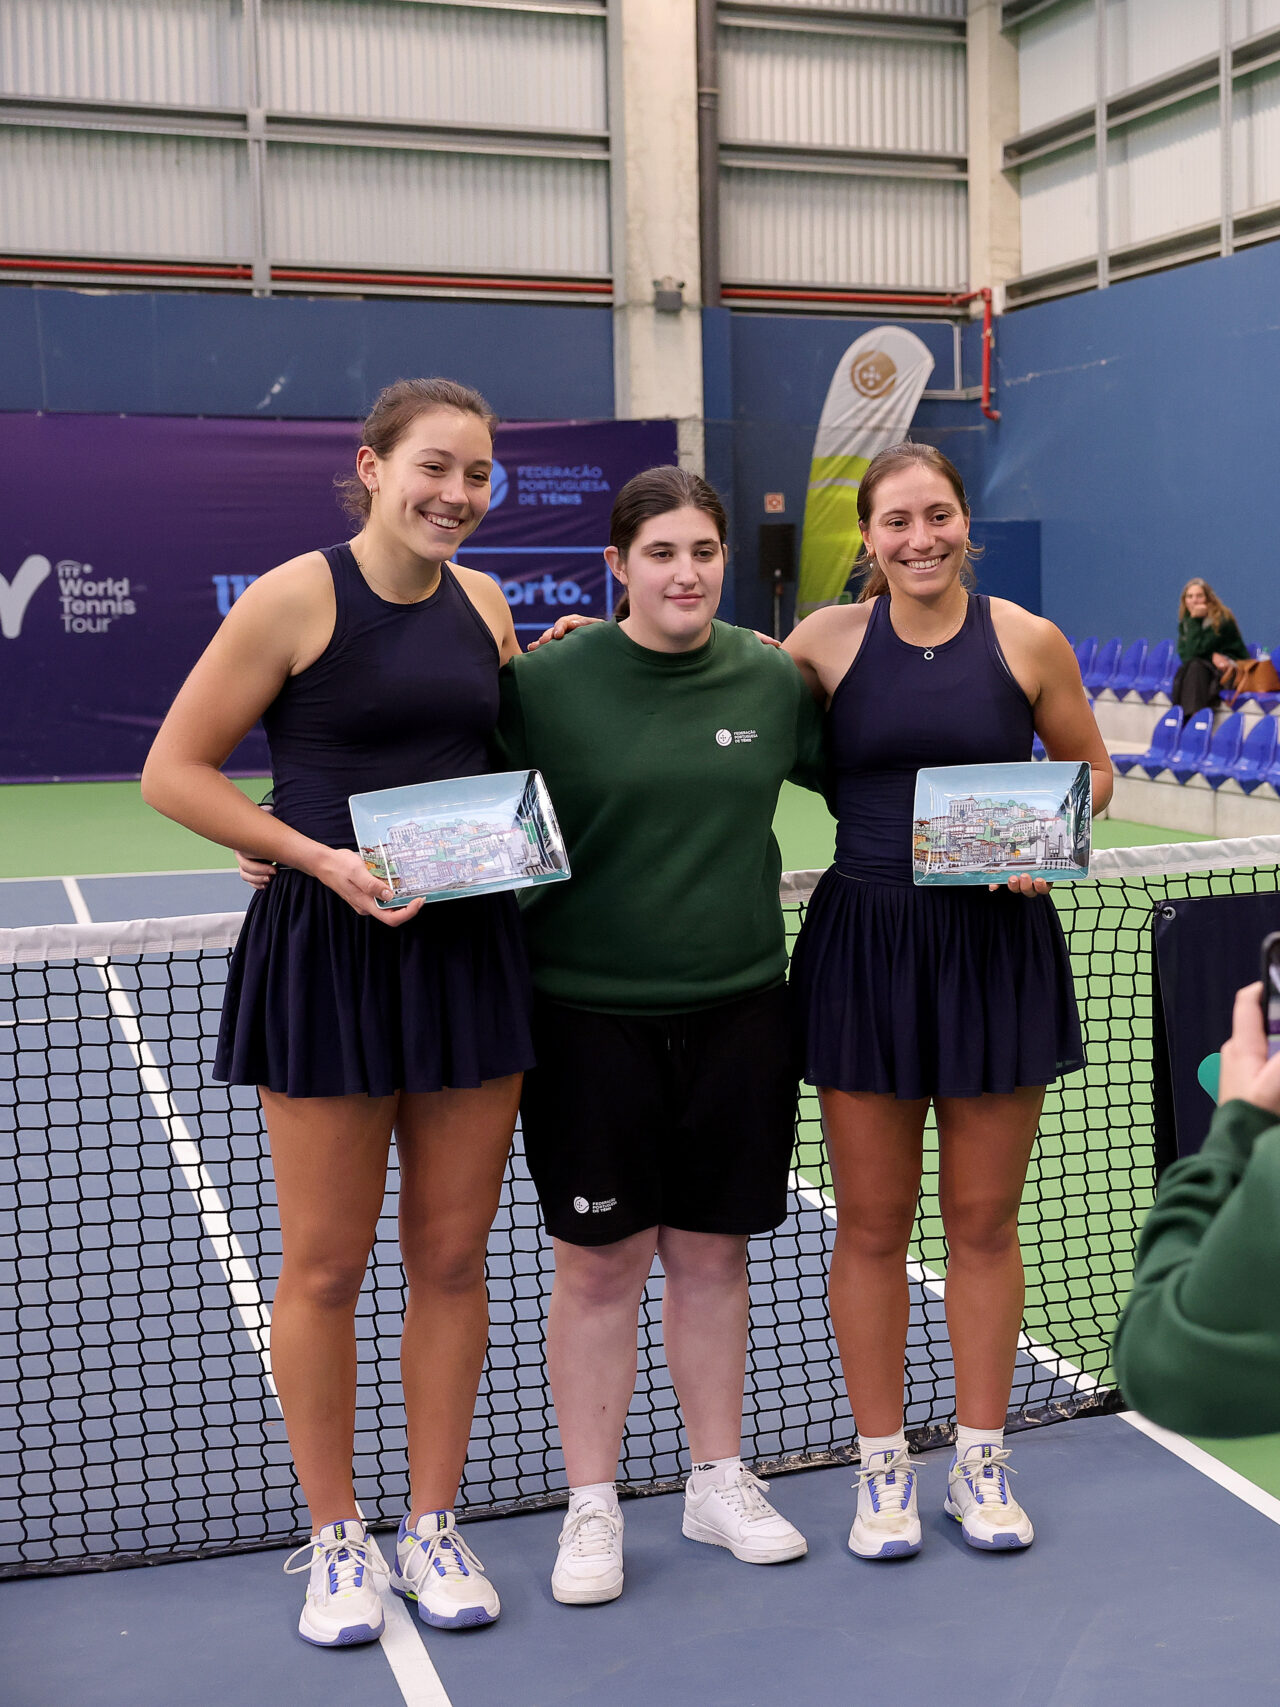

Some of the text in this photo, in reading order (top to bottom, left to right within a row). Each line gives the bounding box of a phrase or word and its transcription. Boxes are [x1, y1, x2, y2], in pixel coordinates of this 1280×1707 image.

[517, 463, 603, 479] FEDERAÇÃO
[517, 479, 611, 492] PORTUGUESA
[518, 493, 538, 505] DE
[59, 577, 130, 597] World
[486, 571, 592, 606] orto.
[59, 596, 137, 615] Tennis
[60, 614, 112, 634] Tour
